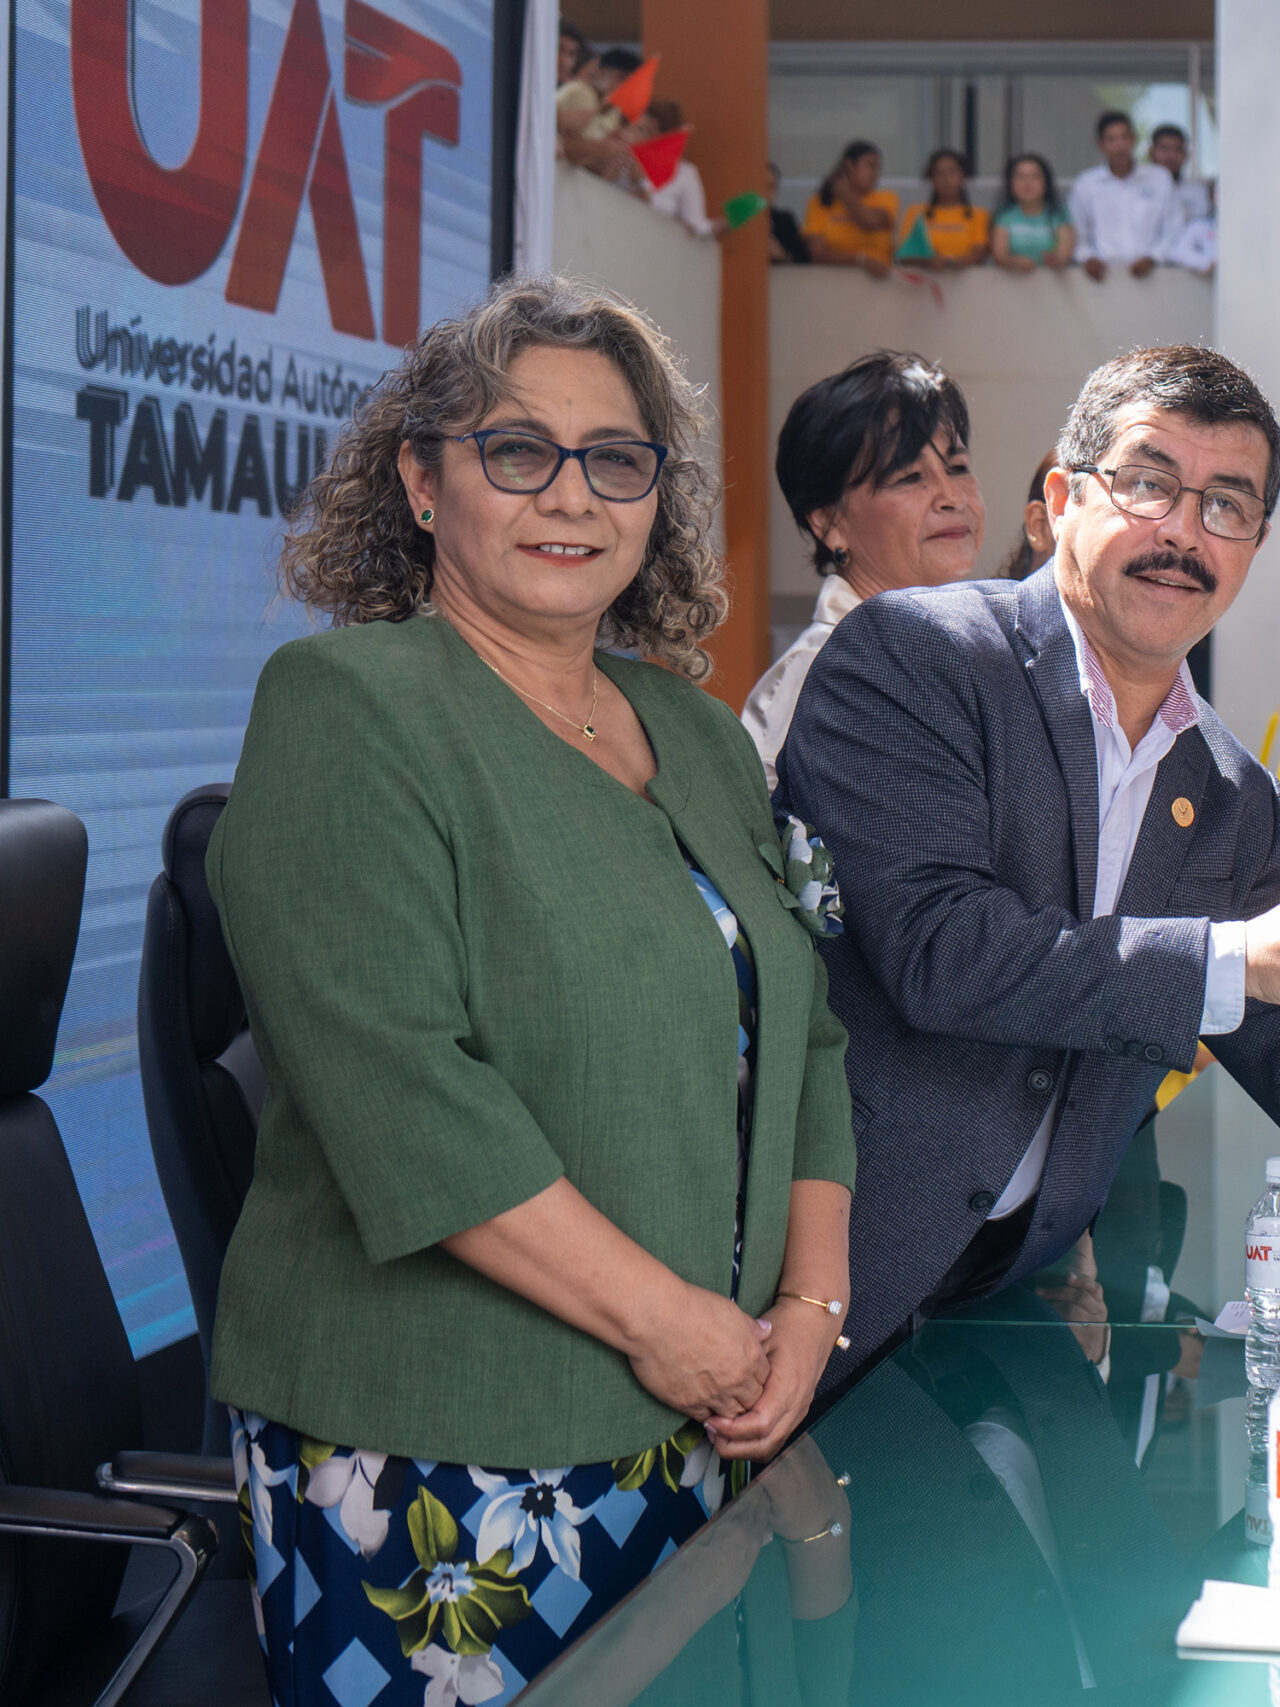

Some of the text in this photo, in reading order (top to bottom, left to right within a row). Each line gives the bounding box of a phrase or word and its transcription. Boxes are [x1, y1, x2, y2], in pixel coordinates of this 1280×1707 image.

[75, 307, 372, 420] Universidad Autón
[1245, 1245, 1272, 1262] UAT
